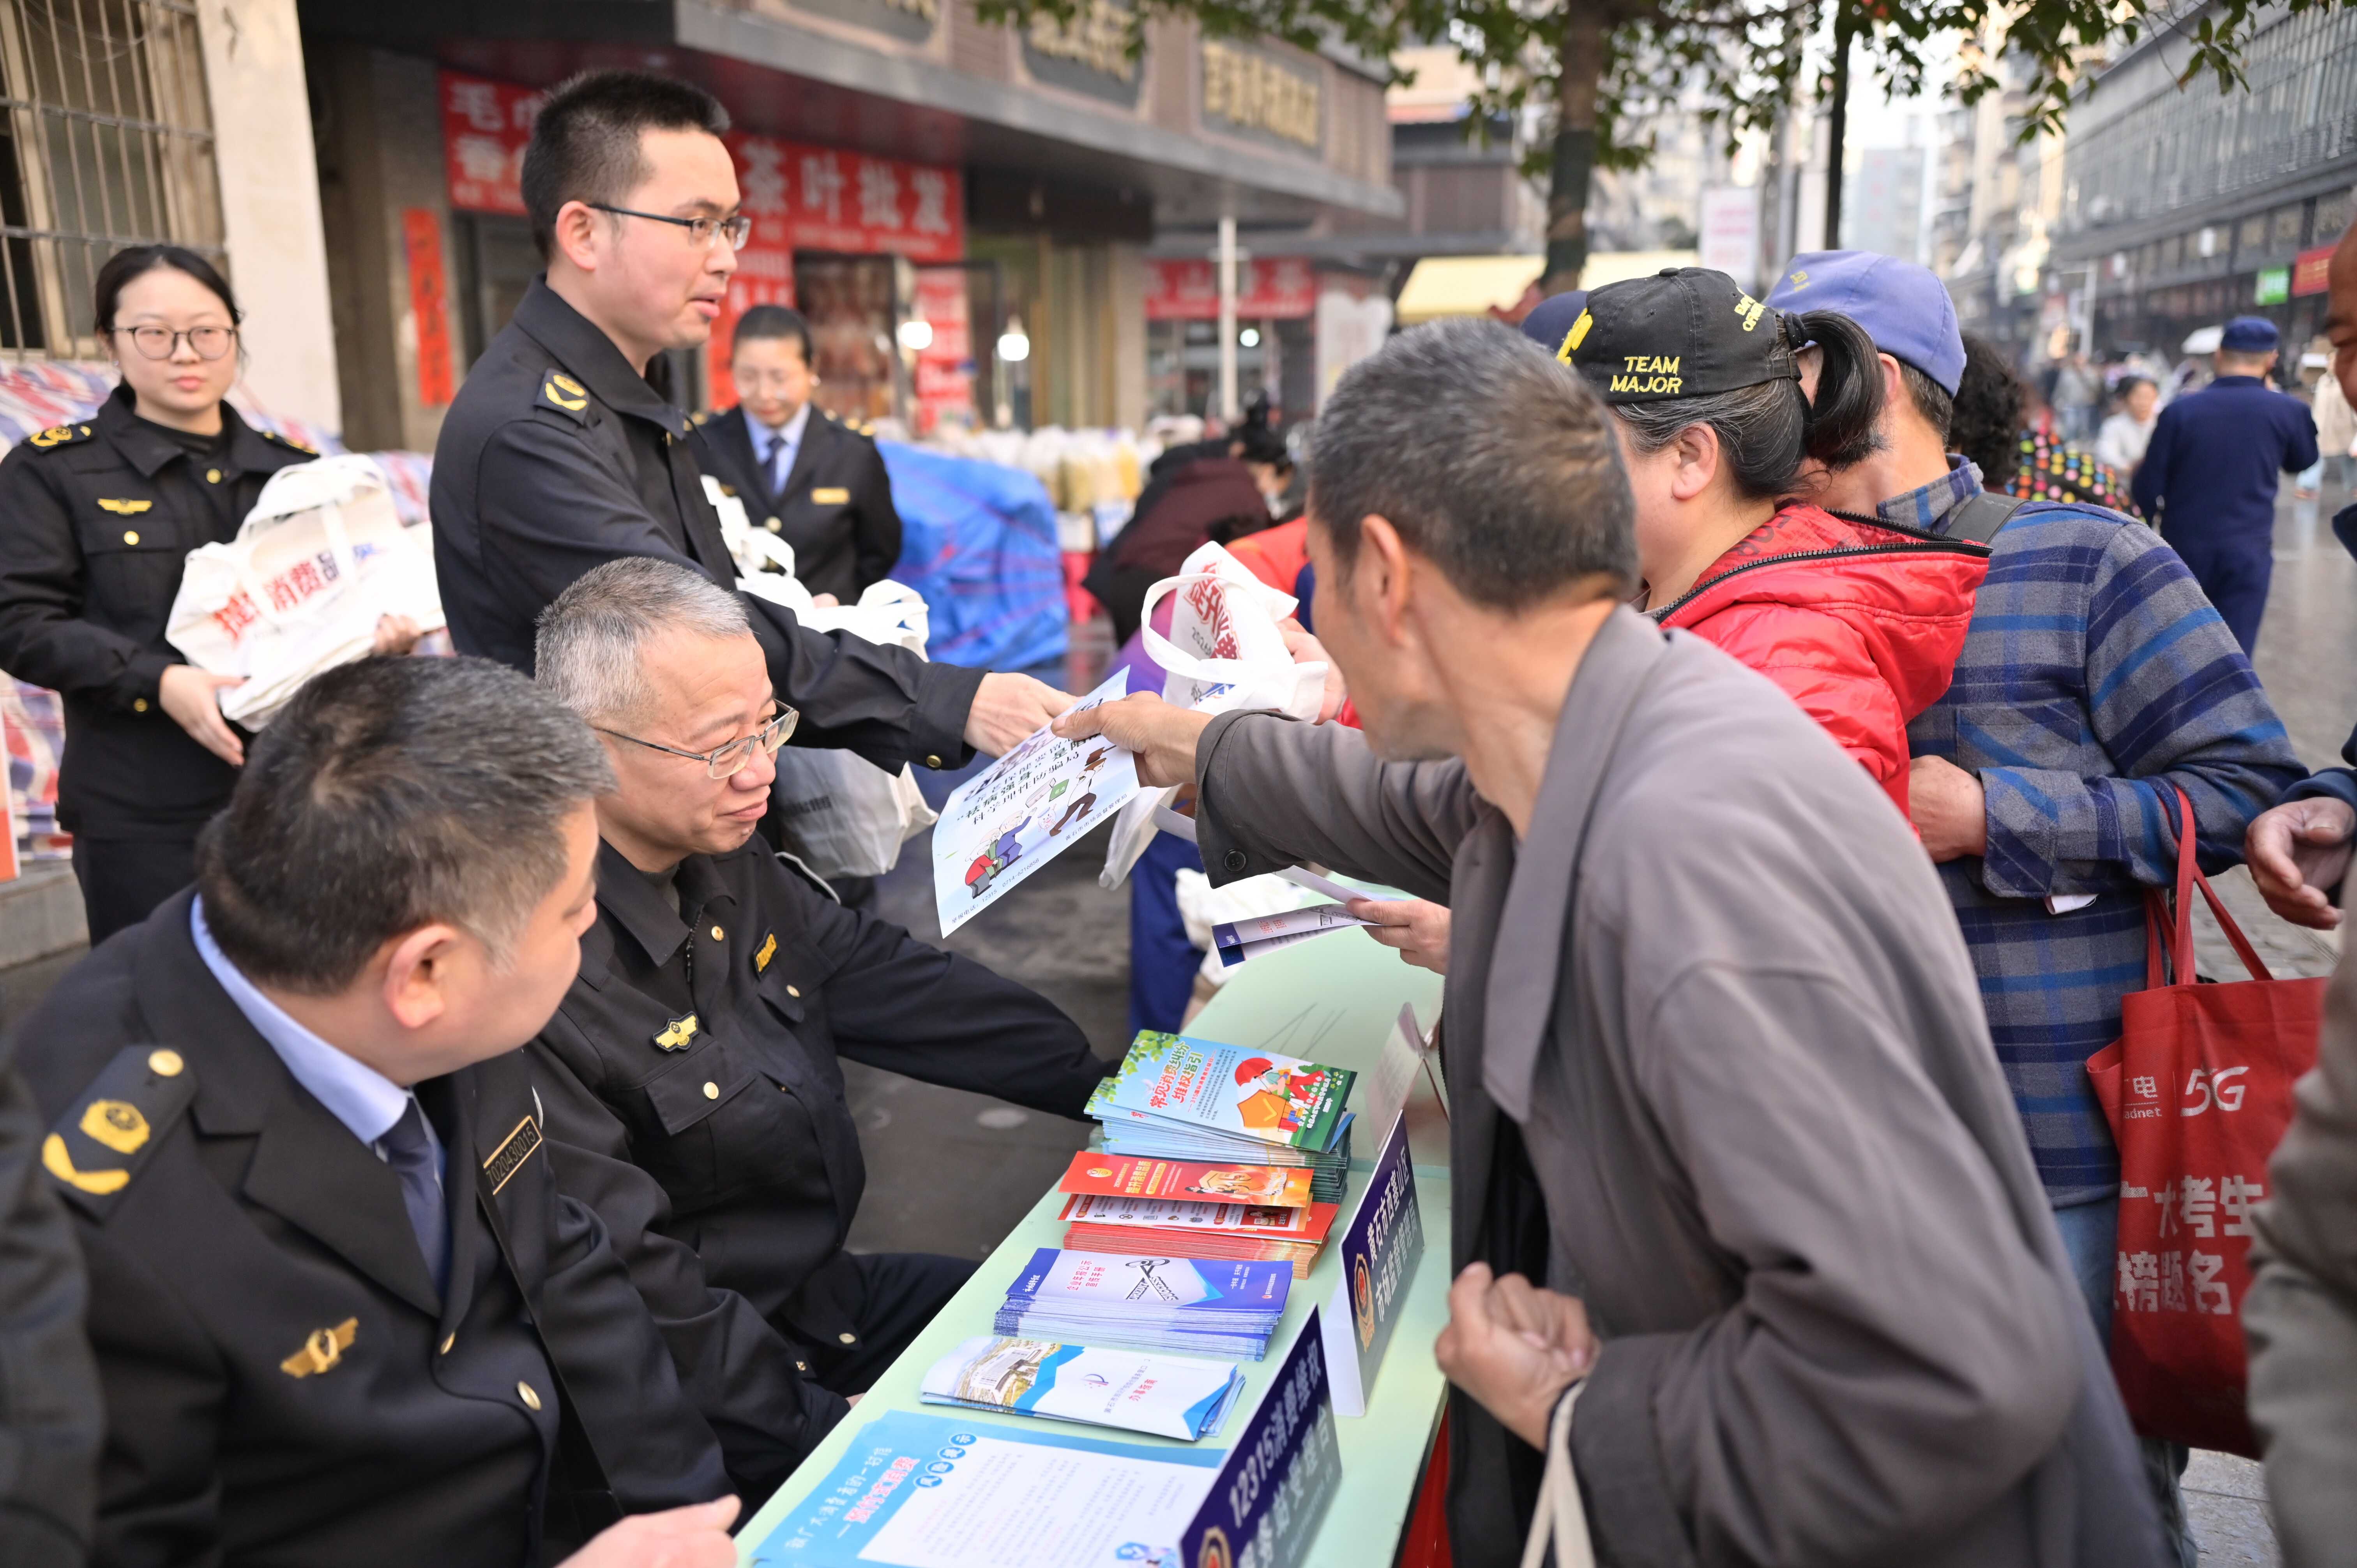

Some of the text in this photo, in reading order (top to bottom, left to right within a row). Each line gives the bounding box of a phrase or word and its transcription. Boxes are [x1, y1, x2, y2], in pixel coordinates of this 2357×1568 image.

[1610, 376, 1683, 393] MAJOR
[1624, 356, 1680, 374] TEAM
[974, 752, 1079, 825] 科学理性防骗局
[1066, 793, 1127, 841] 黄石市市场监督管理局
[982, 890, 997, 902] 12315
[1002, 858, 1039, 887] 0714-6216858
[1150, 1041, 1191, 1109] 常见消费纠纷
[1170, 1051, 1204, 1104] 维权指引
[2124, 1065, 2250, 1117] 电 5G
[2123, 1106, 2163, 1120] adnet
[486, 1126, 536, 1187] 7020430015
[1125, 1160, 1153, 1194] 提升消费品质
[1367, 1145, 1410, 1270] 黄石市西塞山区
[2120, 1174, 2263, 1239] 大考生
[1065, 1260, 1094, 1291] 企业年报公示
[1084, 1266, 1107, 1287] 宣传手册
[1376, 1195, 1417, 1323] 市场监督管理局
[2114, 1249, 2232, 1315] 榜题名
[1125, 1282, 1149, 1300] CREDIT
[1148, 1276, 1178, 1300] SUCCESS
[1127, 1378, 1159, 1402] 办事指南
